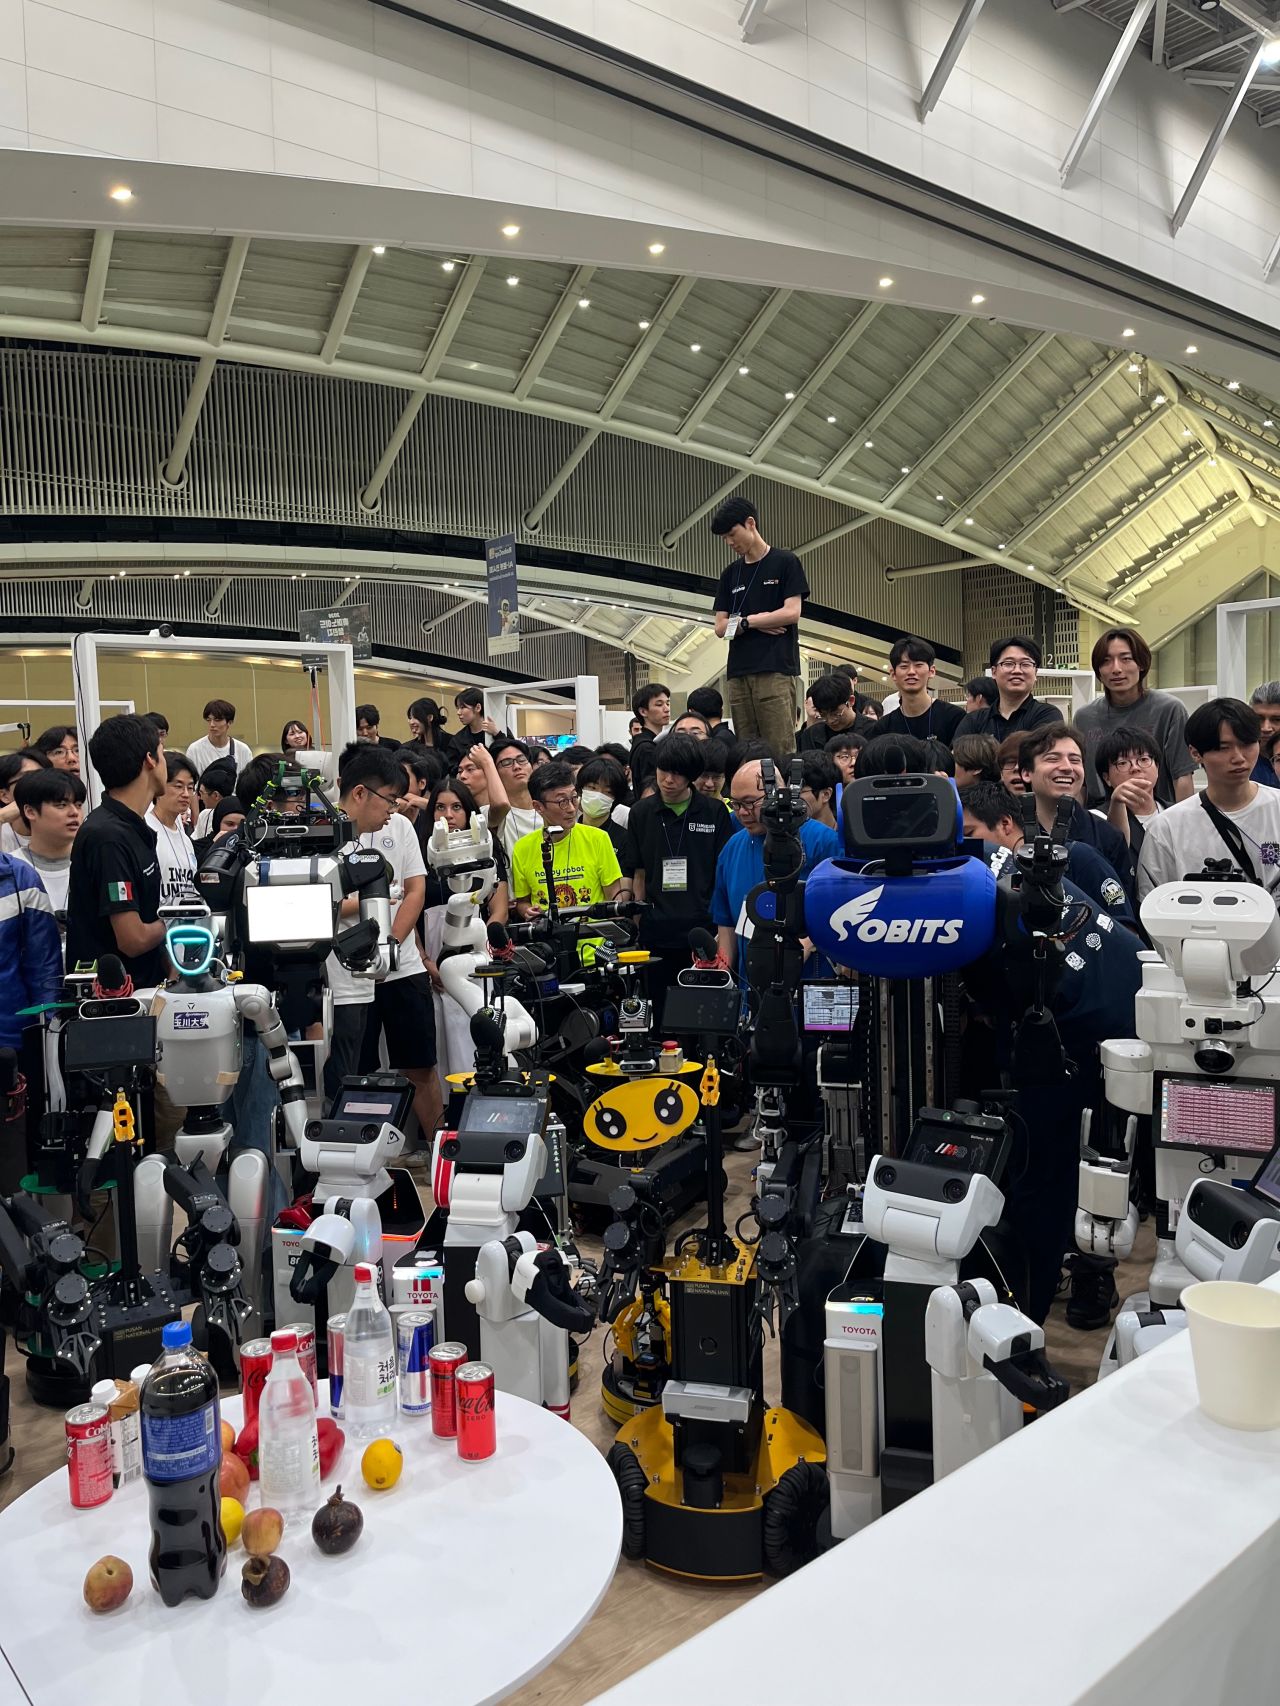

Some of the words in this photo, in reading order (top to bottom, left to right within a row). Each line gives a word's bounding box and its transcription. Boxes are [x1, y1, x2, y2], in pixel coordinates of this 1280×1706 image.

[1047, 653, 1054, 665] 2
[562, 865, 585, 874] robot
[282, 1240, 300, 1248] TOYO
[841, 1325, 877, 1336] TOYOTA
